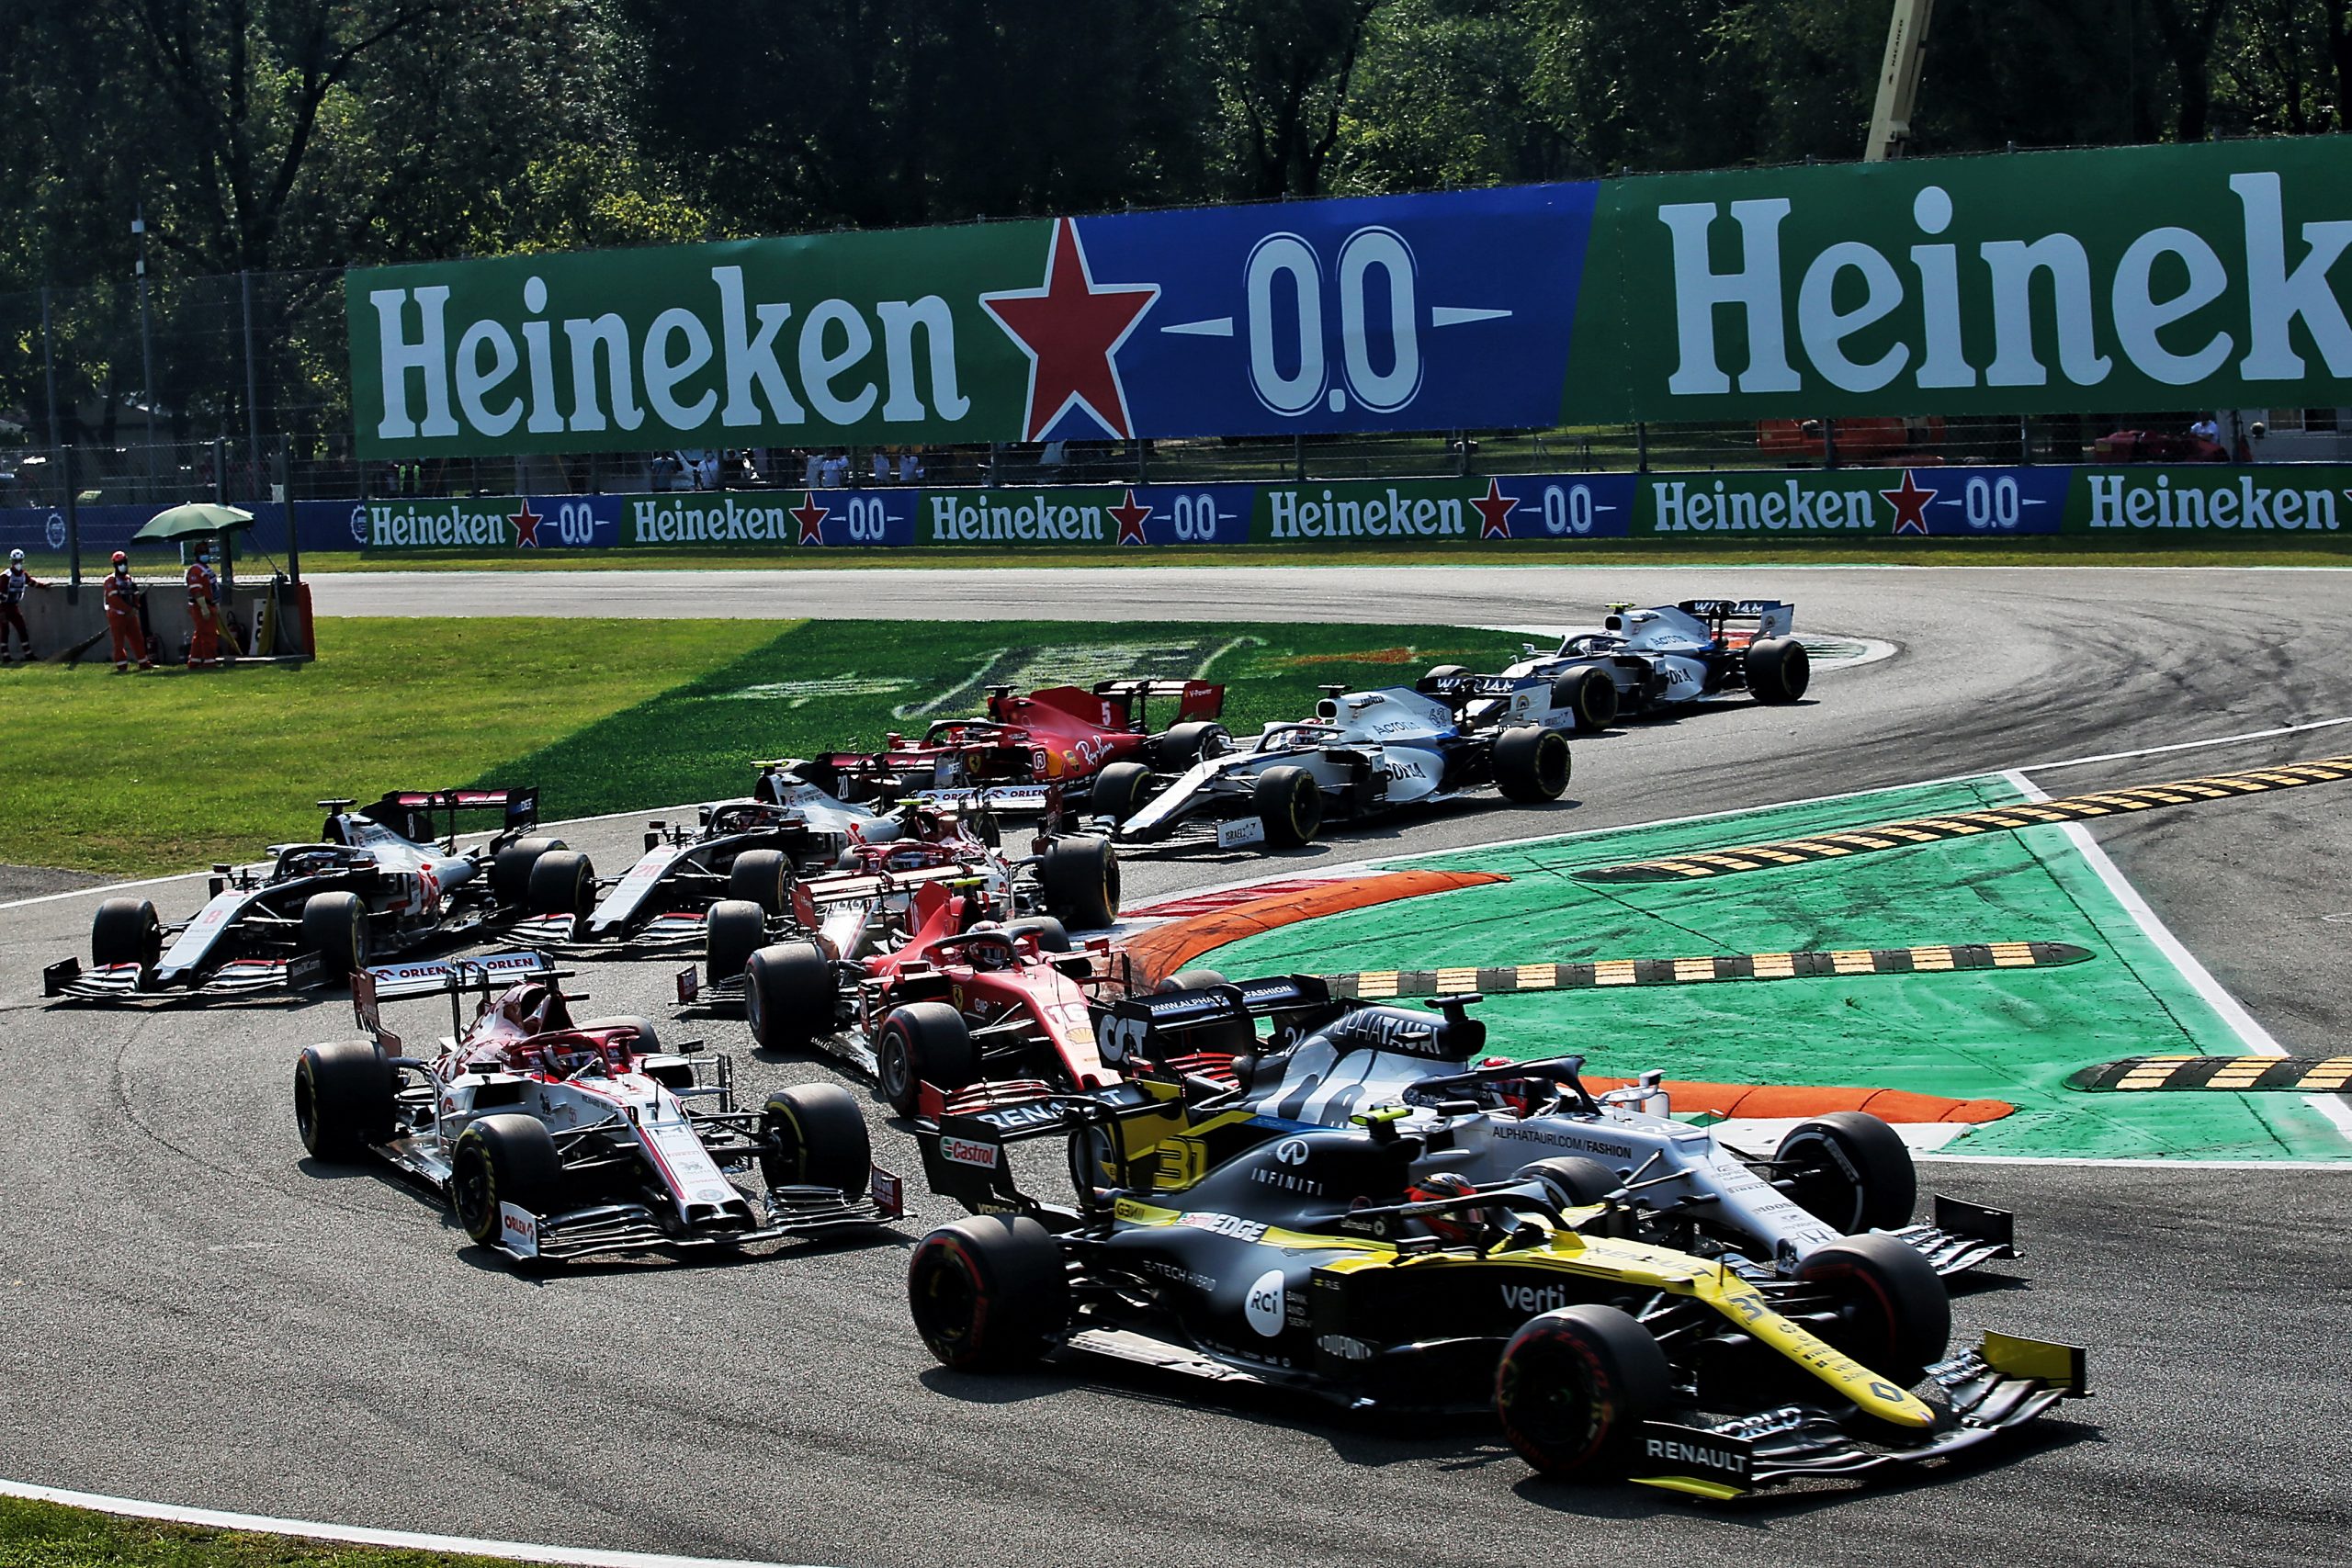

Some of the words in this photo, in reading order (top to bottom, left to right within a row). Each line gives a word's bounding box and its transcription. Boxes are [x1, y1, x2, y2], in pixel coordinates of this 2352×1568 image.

[370, 265, 970, 439] Heineken
[1243, 225, 1423, 417] 0.0
[930, 496, 1103, 540] Heineken
[1173, 494, 1216, 540] 0.0
[1269, 489, 1465, 537] Heineken
[1543, 484, 1593, 535] 0.0
[1653, 479, 1875, 532] Heineken
[1965, 475, 2019, 529] 0.0
[2087, 474, 2340, 530] Heineken
[371, 505, 505, 547] Heineken
[559, 502, 594, 545] 0.0
[634, 499, 786, 542] Heineken
[847, 497, 886, 540] 0.0
[1102, 702, 1111, 726] 5
[837, 775, 849, 800] 20
[1011, 789, 1046, 798] ORLEN
[407, 813, 415, 839] 8
[399, 966, 447, 978] ORLEN
[487, 958, 535, 970] ORLEN
[953, 1141, 994, 1165] Castrol
[1492, 1125, 1633, 1159] ALPHATAURI.COM/FASHION
[1152, 1136, 1208, 1191] 31
[1251, 1168, 1323, 1196] INFINITI
[504, 1215, 527, 1236] ORLEN
[1204, 1213, 1269, 1243] EDGE
[1500, 1284, 1566, 1313] verti
[1646, 1438, 1747, 1473] RENAULT
